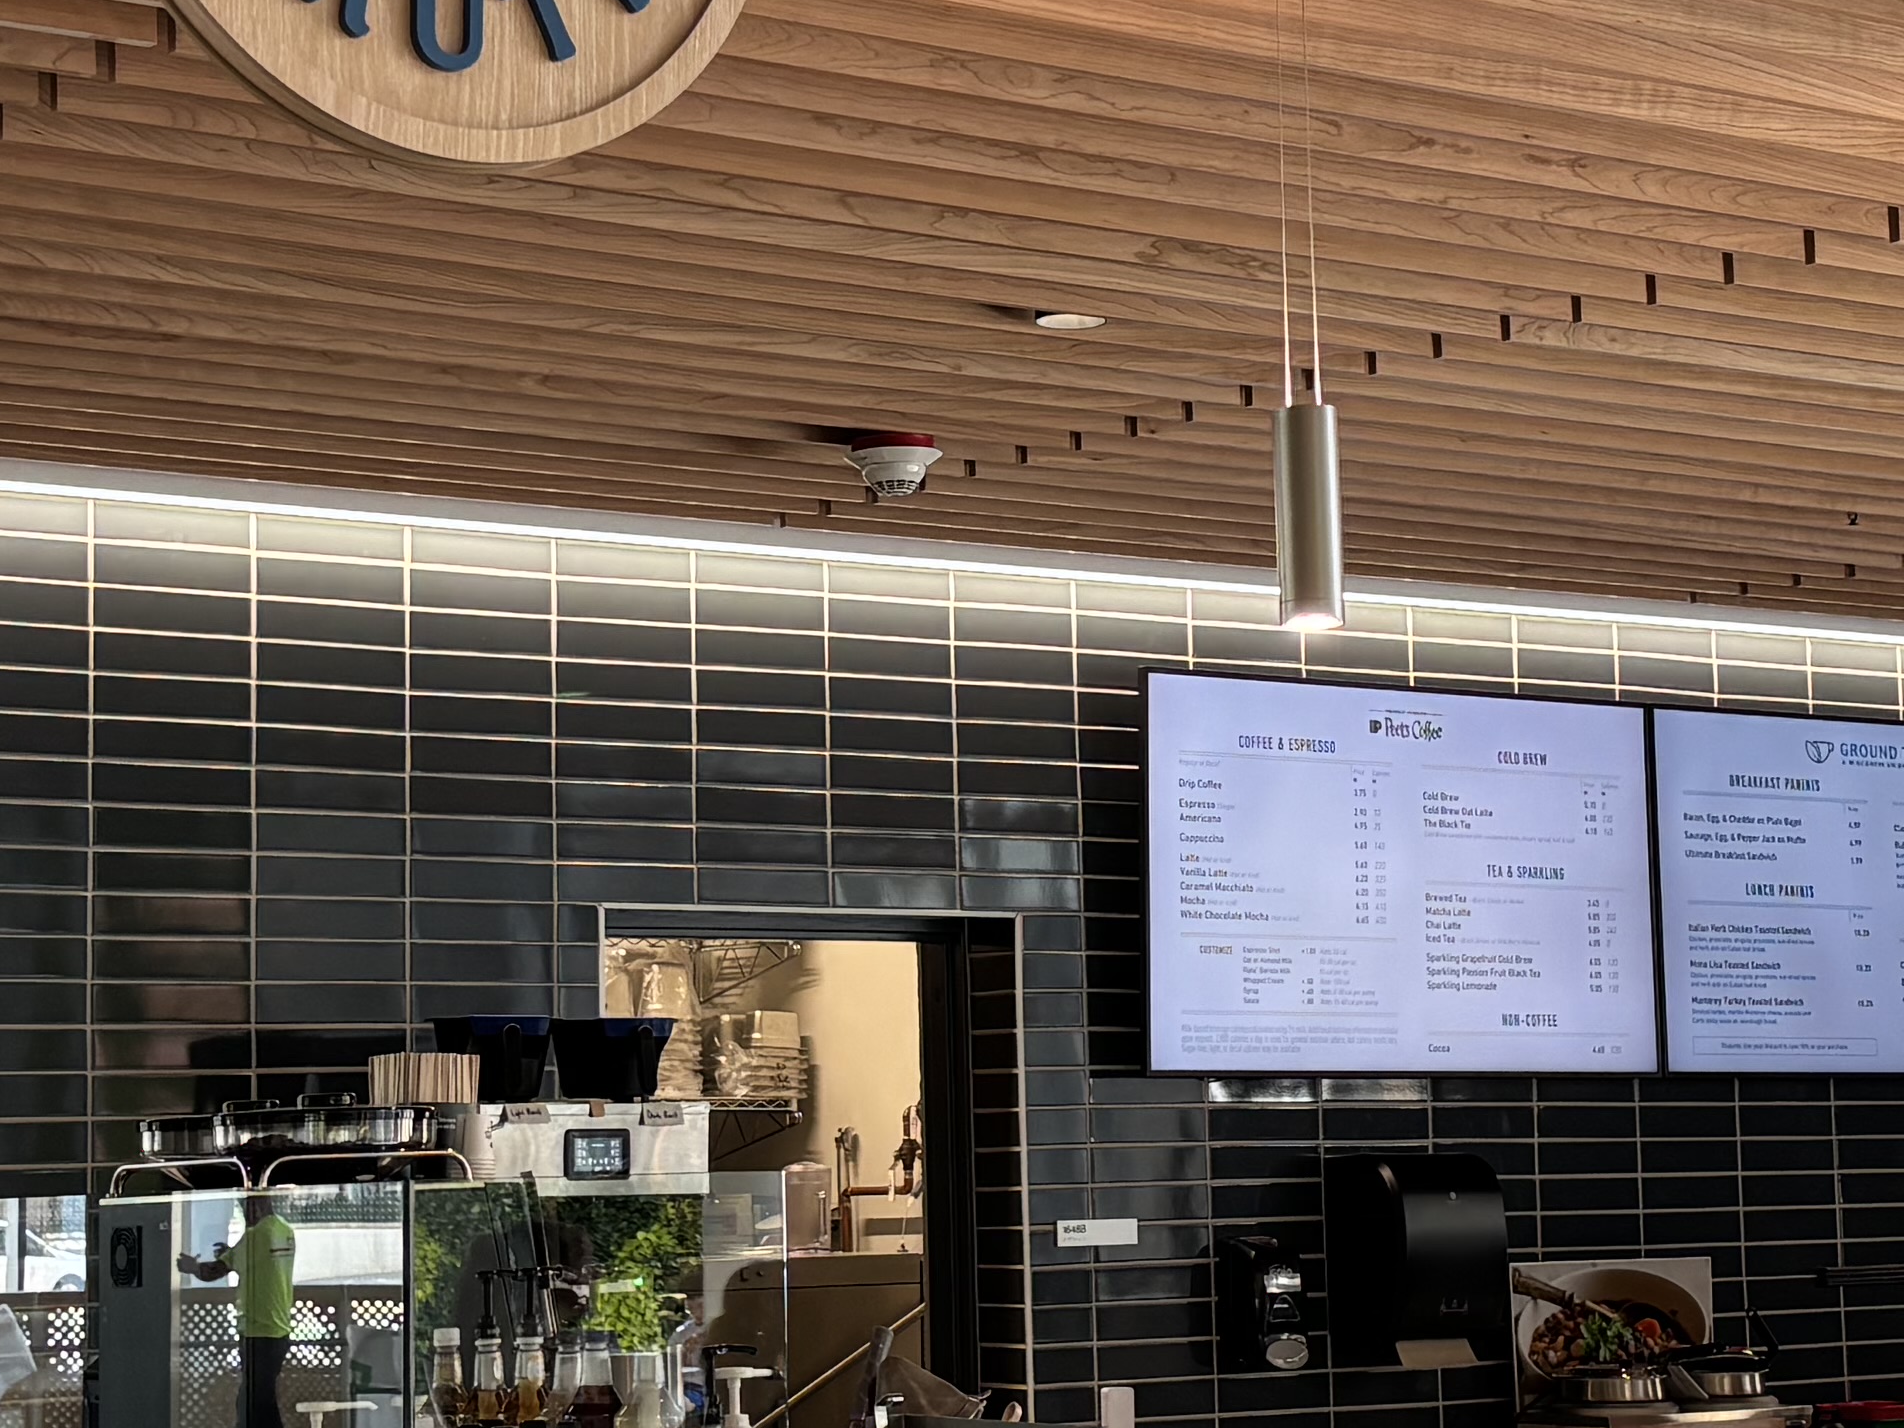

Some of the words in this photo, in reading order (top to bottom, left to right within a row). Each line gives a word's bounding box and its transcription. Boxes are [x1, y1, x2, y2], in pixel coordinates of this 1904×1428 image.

[1239, 735, 1273, 749] COFFEE
[1278, 738, 1284, 749] &
[1289, 738, 1335, 753] ESPRESSO
[1840, 743, 1897, 761] GROUND
[1498, 751, 1519, 764] COLD
[1523, 752, 1547, 766] BREW
[1179, 779, 1195, 789] Drip
[1197, 780, 1222, 790] Coffee
[1729, 774, 1780, 790] BREAKFAST
[1785, 778, 1820, 792] PANINIS
[1423, 791, 1438, 801] Cold
[1441, 792, 1459, 801] Brew
[1179, 799, 1215, 810] Espresso
[1423, 806, 1439, 815] Cold
[1441, 806, 1459, 816] Brew
[1180, 813, 1221, 823] Americano
[1424, 819, 1436, 829] The
[1439, 820, 1458, 829] Black
[1180, 833, 1224, 844] Cappuccino
[1180, 867, 1206, 877] Vanilla
[1208, 868, 1227, 877] Latte
[1487, 864, 1503, 878] TEA
[1517, 866, 1564, 880] SPARKLING
[1180, 882, 1213, 891] Caramel
[1215, 883, 1253, 892] Macchiato
[1779, 884, 1814, 898] PANINIS
[1181, 896, 1205, 905] Mocha
[1425, 893, 1452, 902] Brewed
[1455, 894, 1466, 903] Tea
[1181, 910, 1203, 919] White
[1205, 911, 1242, 921] Chocolate
[1244, 912, 1269, 921] Mocha
[1426, 907, 1451, 916] Matcha
[1426, 921, 1441, 929] Chai
[1443, 921, 1461, 930] Latte
[1426, 934, 1440, 943] Iced
[1443, 935, 1455, 944] Tea
[1426, 953, 1460, 964] Sparkling
[1498, 955, 1513, 964] Cold
[1515, 956, 1532, 964] Brew
[1426, 967, 1460, 978] Sparkling
[1529, 970, 1540, 978] Tea
[1427, 981, 1460, 991] Sparkling
[1462, 981, 1497, 991] Lemonade
[1502, 1014, 1557, 1027] NON-COFFEE
